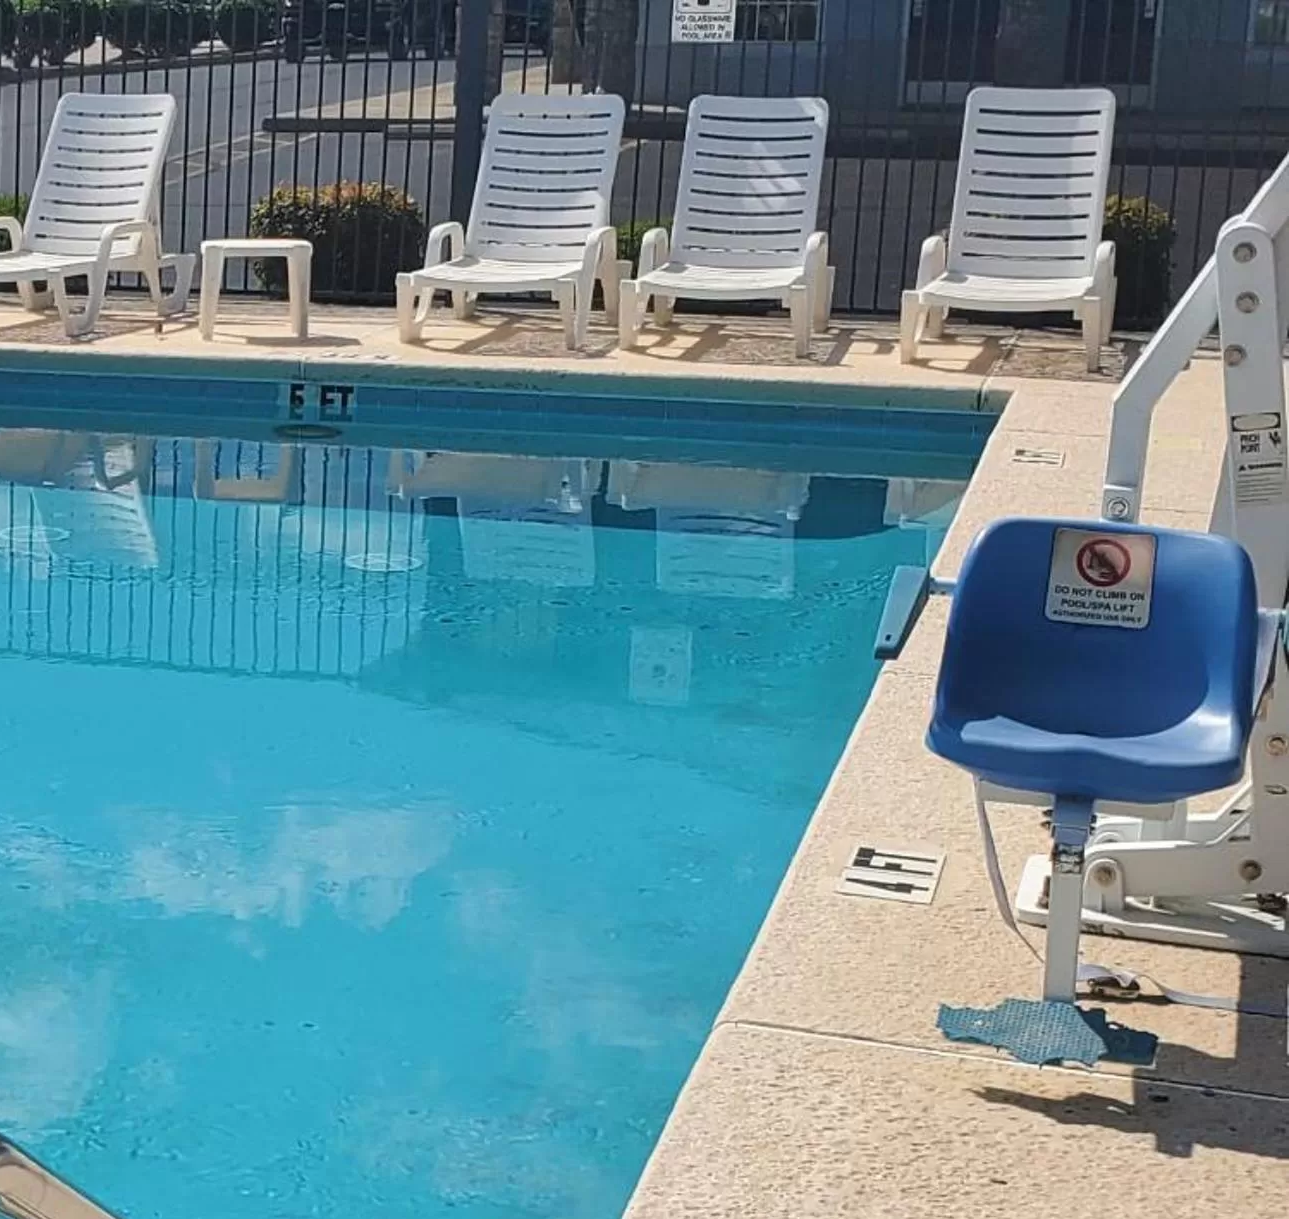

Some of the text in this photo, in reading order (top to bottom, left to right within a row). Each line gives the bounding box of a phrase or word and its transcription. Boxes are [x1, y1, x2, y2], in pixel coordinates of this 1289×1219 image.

[1055, 585, 1145, 601] DO NOT CLIMB ON
[1061, 599, 1135, 613] POOL/SPA LIFT
[853, 847, 937, 876] FT
